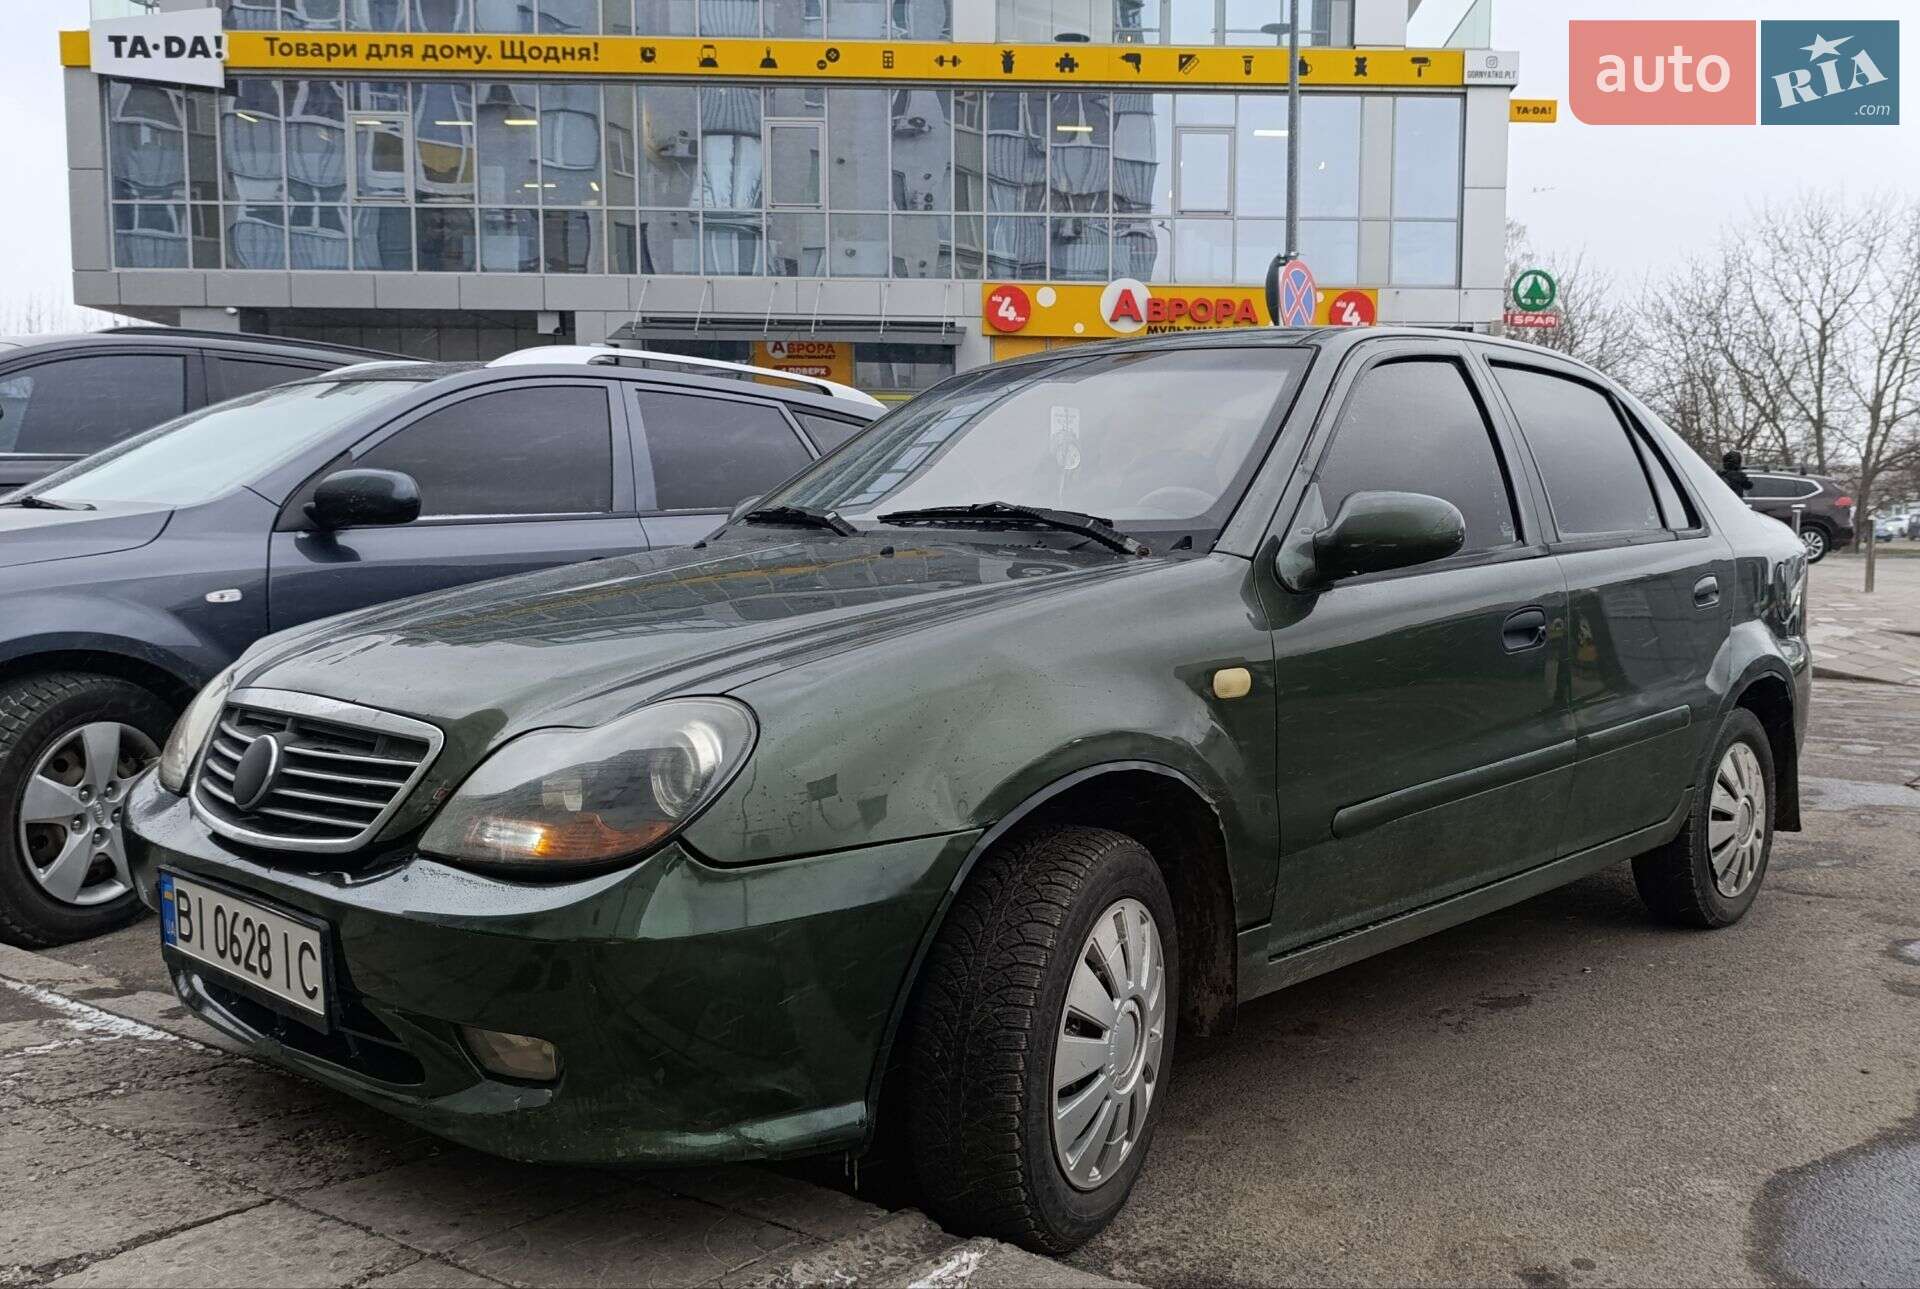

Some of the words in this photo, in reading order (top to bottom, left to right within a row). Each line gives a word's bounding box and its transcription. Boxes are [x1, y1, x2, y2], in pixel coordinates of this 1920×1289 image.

[264, 36, 358, 62] Товари
[365, 43, 414, 61] для
[421, 43, 493, 65] дому.
[499, 39, 600, 64] Щодня!
[998, 296, 1017, 321] 4
[1109, 288, 1259, 324] АВРОРА
[1341, 301, 1361, 326] 4
[1513, 315, 1556, 326] SPAR
[772, 341, 836, 354] АВРОРА
[176, 888, 205, 951] BI
[213, 904, 273, 980] 0628
[283, 931, 319, 1000] IC
